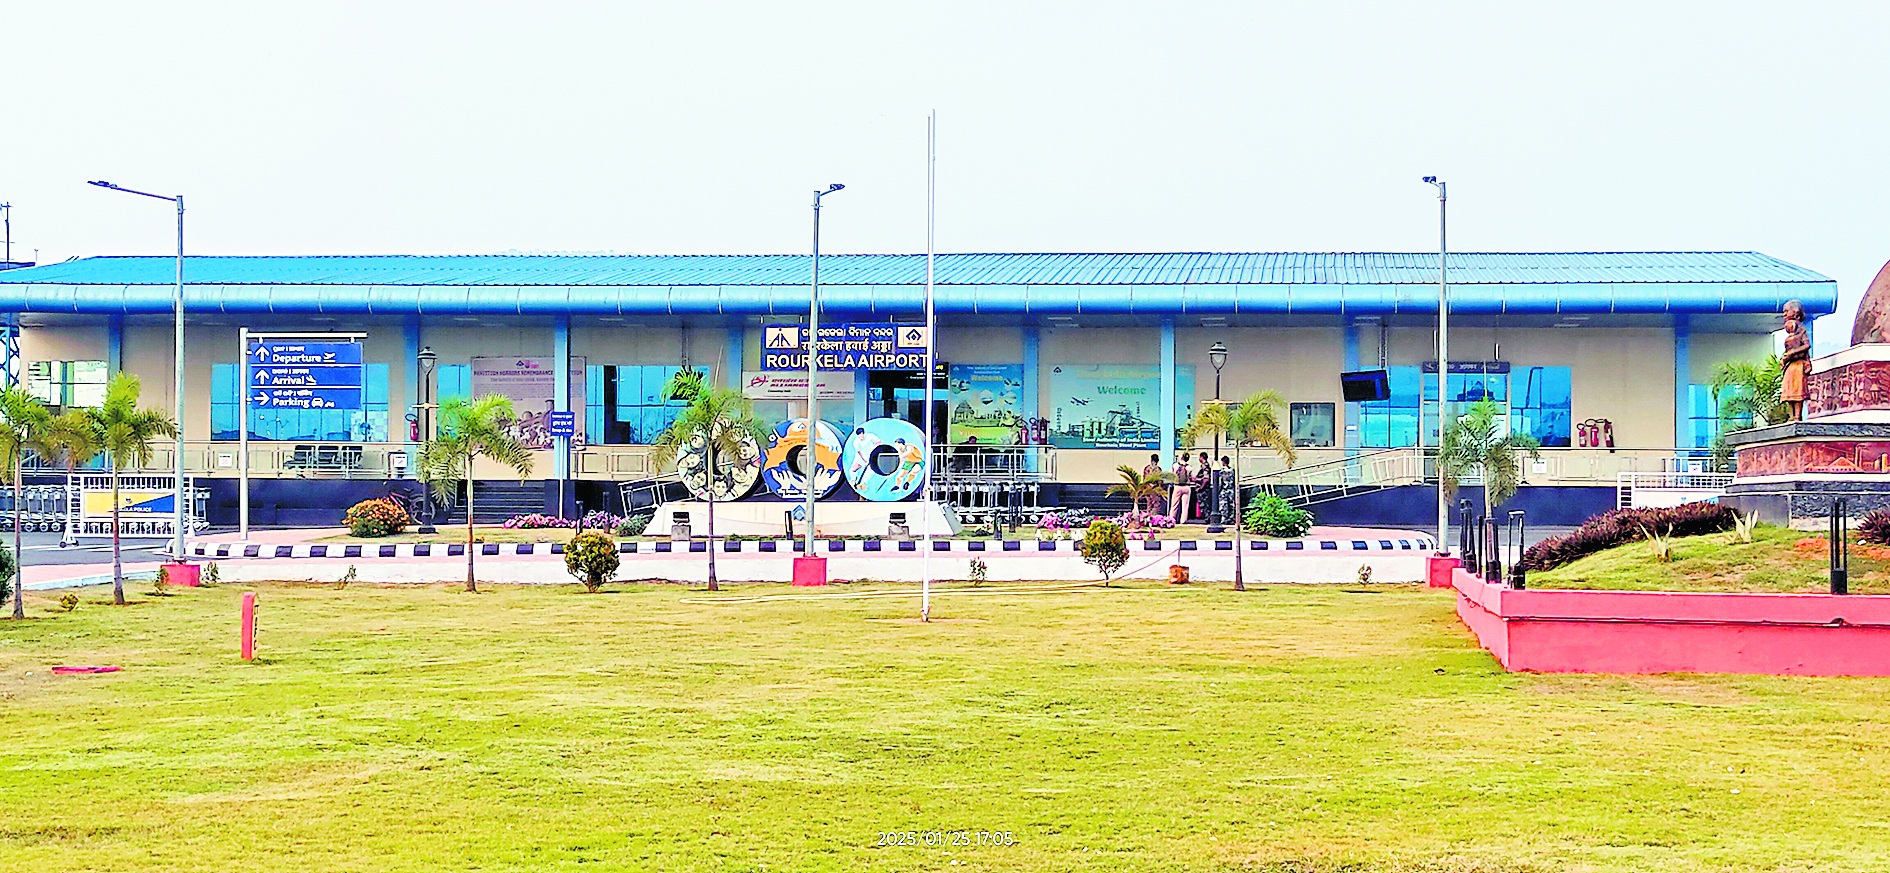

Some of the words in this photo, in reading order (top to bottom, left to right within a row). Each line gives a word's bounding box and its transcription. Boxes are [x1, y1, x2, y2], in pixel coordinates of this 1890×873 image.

[272, 353, 322, 365] Departure
[271, 375, 305, 385] Arrival
[1096, 385, 1147, 395] Welcome
[272, 397, 310, 409] Parking
